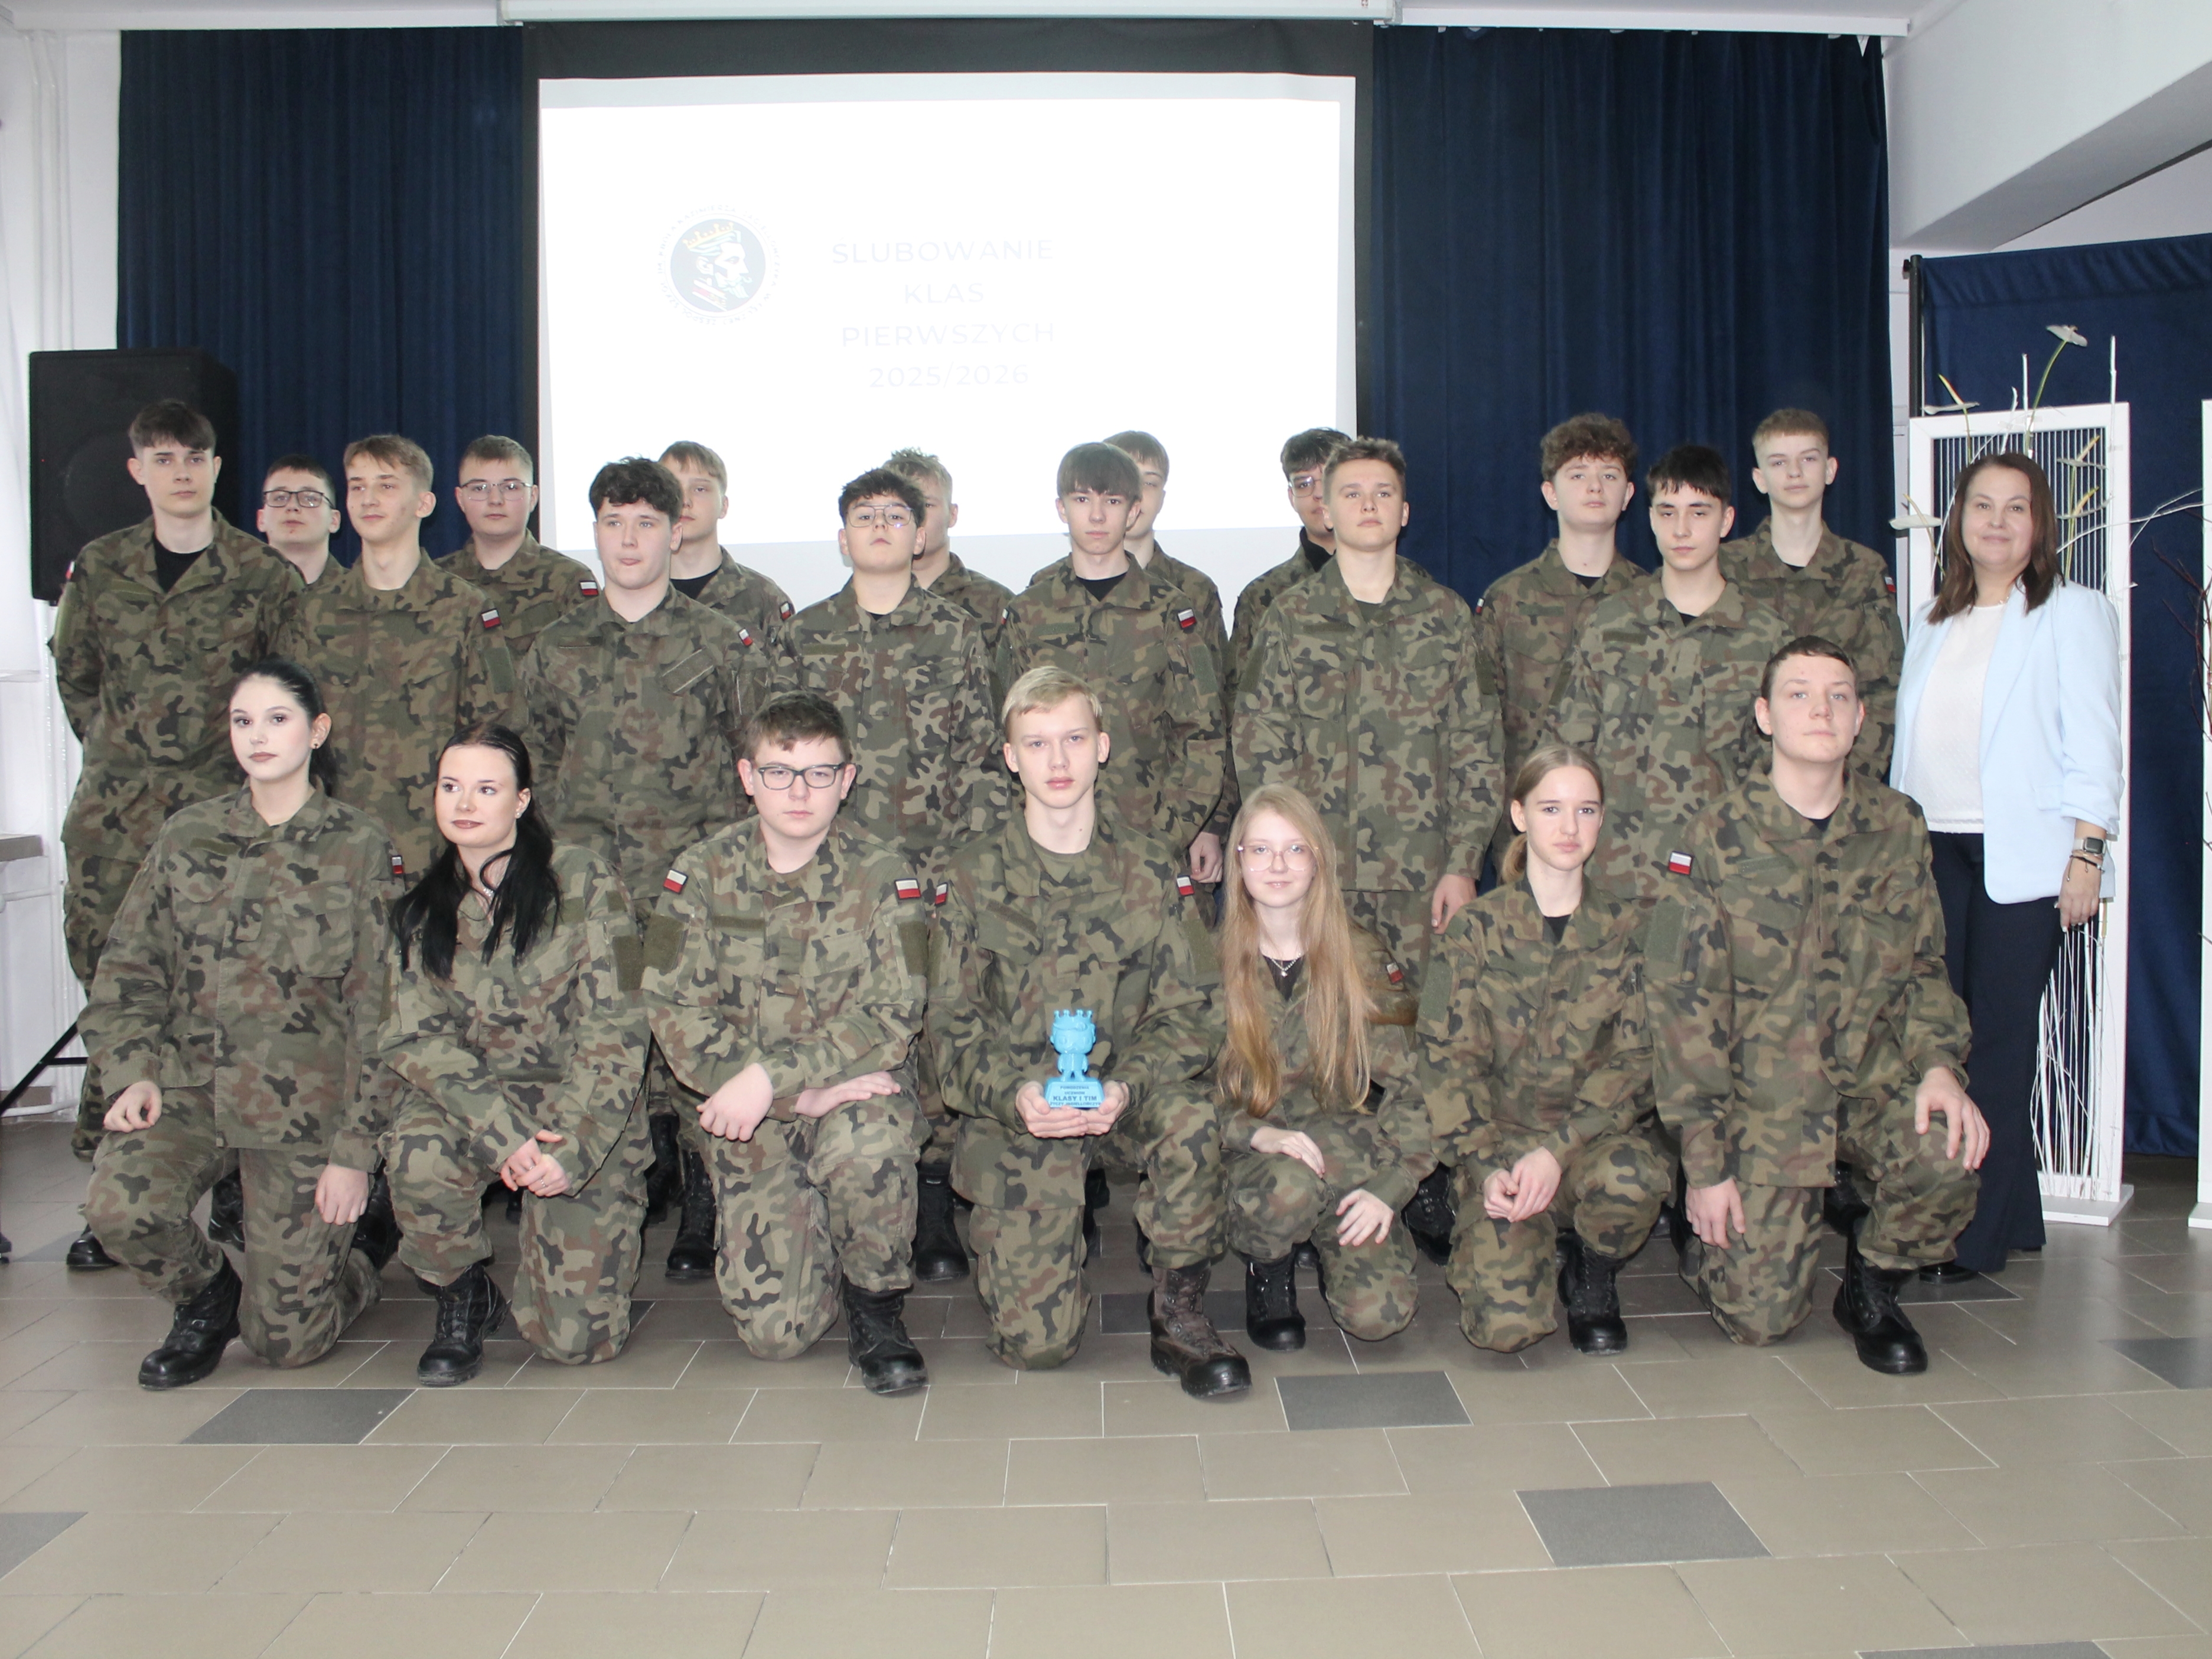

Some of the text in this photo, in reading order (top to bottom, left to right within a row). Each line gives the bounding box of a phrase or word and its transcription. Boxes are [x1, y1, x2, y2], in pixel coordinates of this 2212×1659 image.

[904, 282, 984, 304] KLAS
[842, 322, 1053, 347] PIERWSZYCH
[868, 361, 1029, 389] 2025/2026
